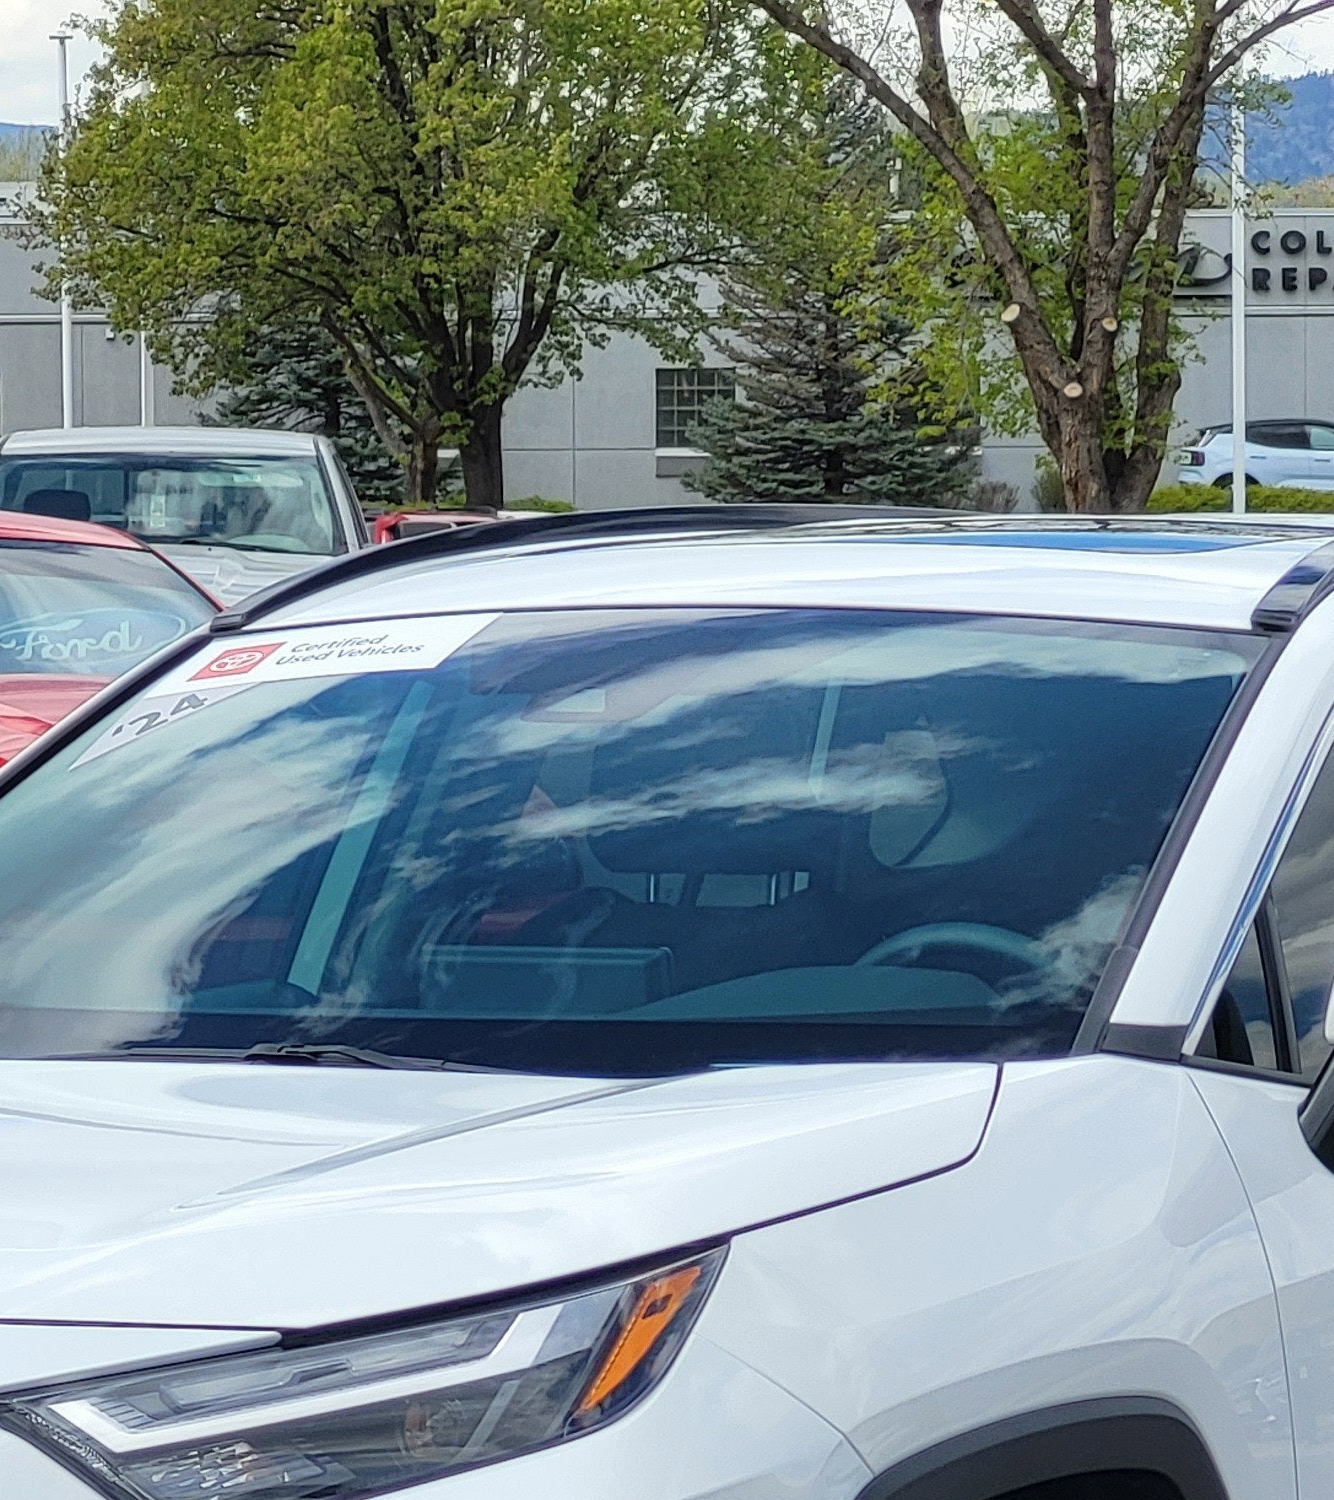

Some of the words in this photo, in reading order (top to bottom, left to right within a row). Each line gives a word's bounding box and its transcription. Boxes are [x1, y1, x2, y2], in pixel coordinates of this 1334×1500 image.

[275, 648, 333, 666] Used
[336, 642, 426, 659] Vehicles
[290, 634, 390, 653] Certified
